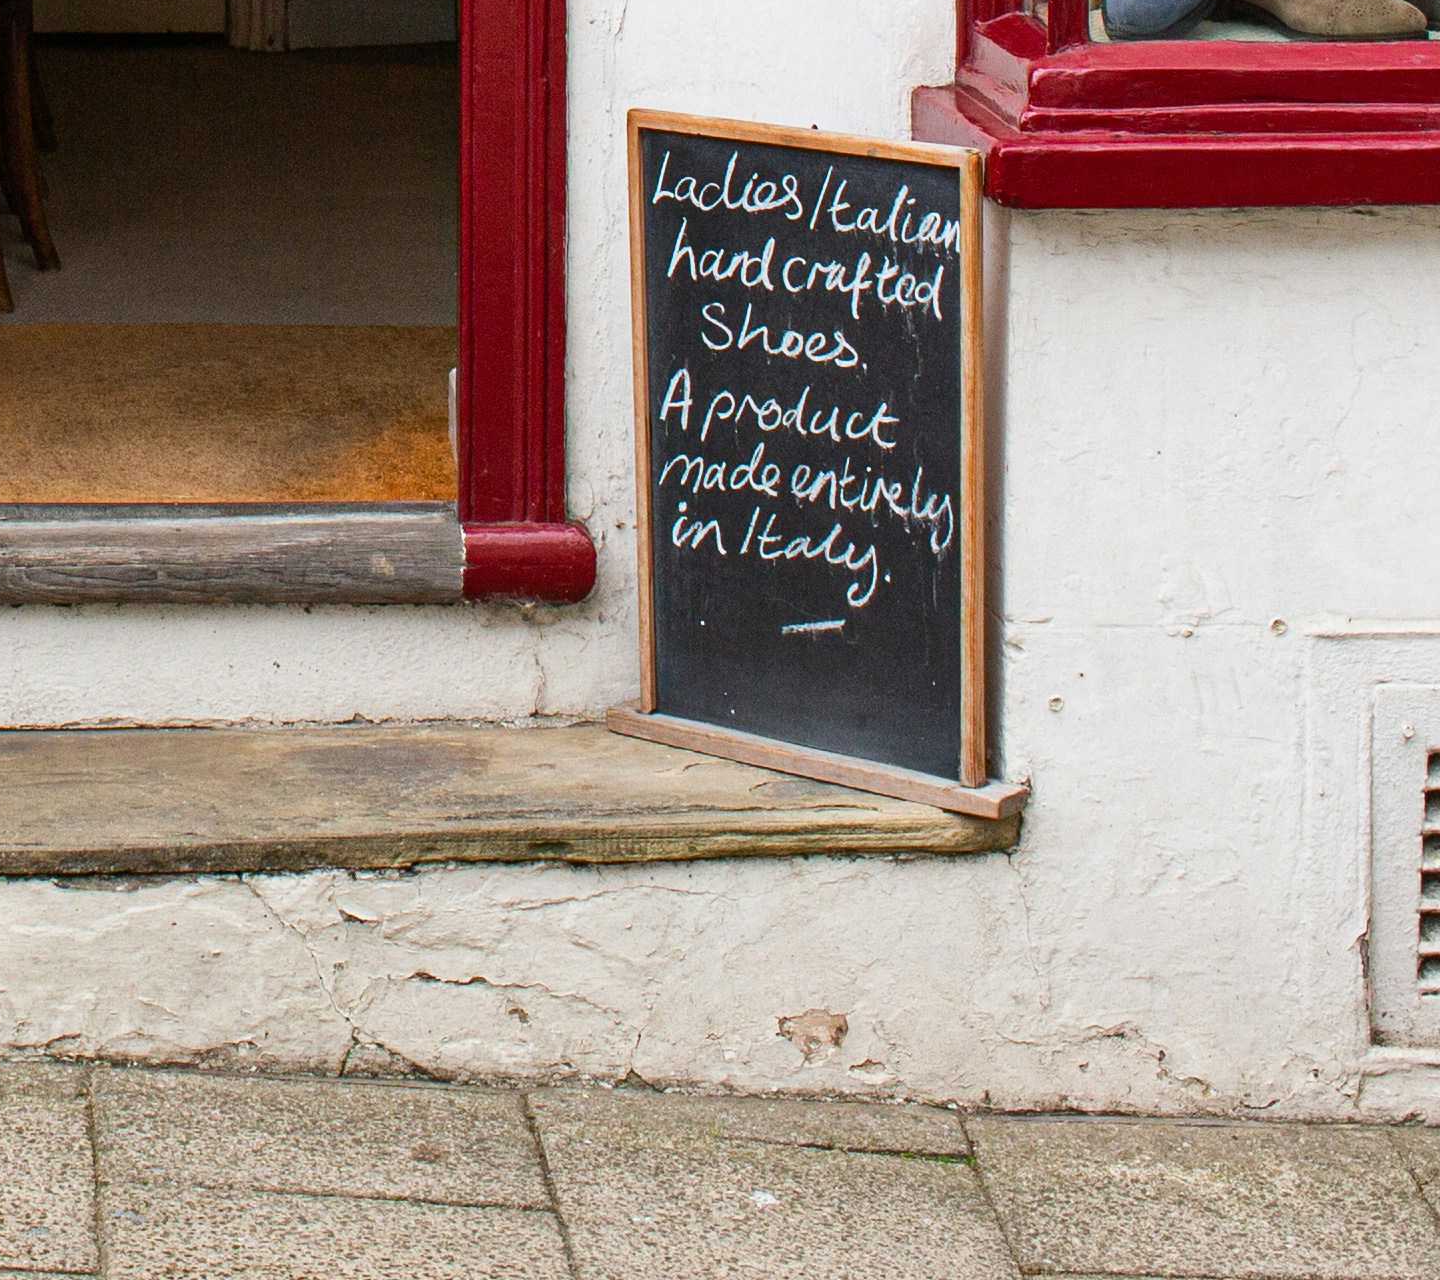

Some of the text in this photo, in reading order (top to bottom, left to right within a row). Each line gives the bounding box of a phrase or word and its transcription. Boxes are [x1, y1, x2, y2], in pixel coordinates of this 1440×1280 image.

[653, 151, 961, 252] Ladies Italian
[659, 369, 898, 448] A product
[659, 443, 956, 552] made entirely
[672, 503, 891, 608] in Italy.
